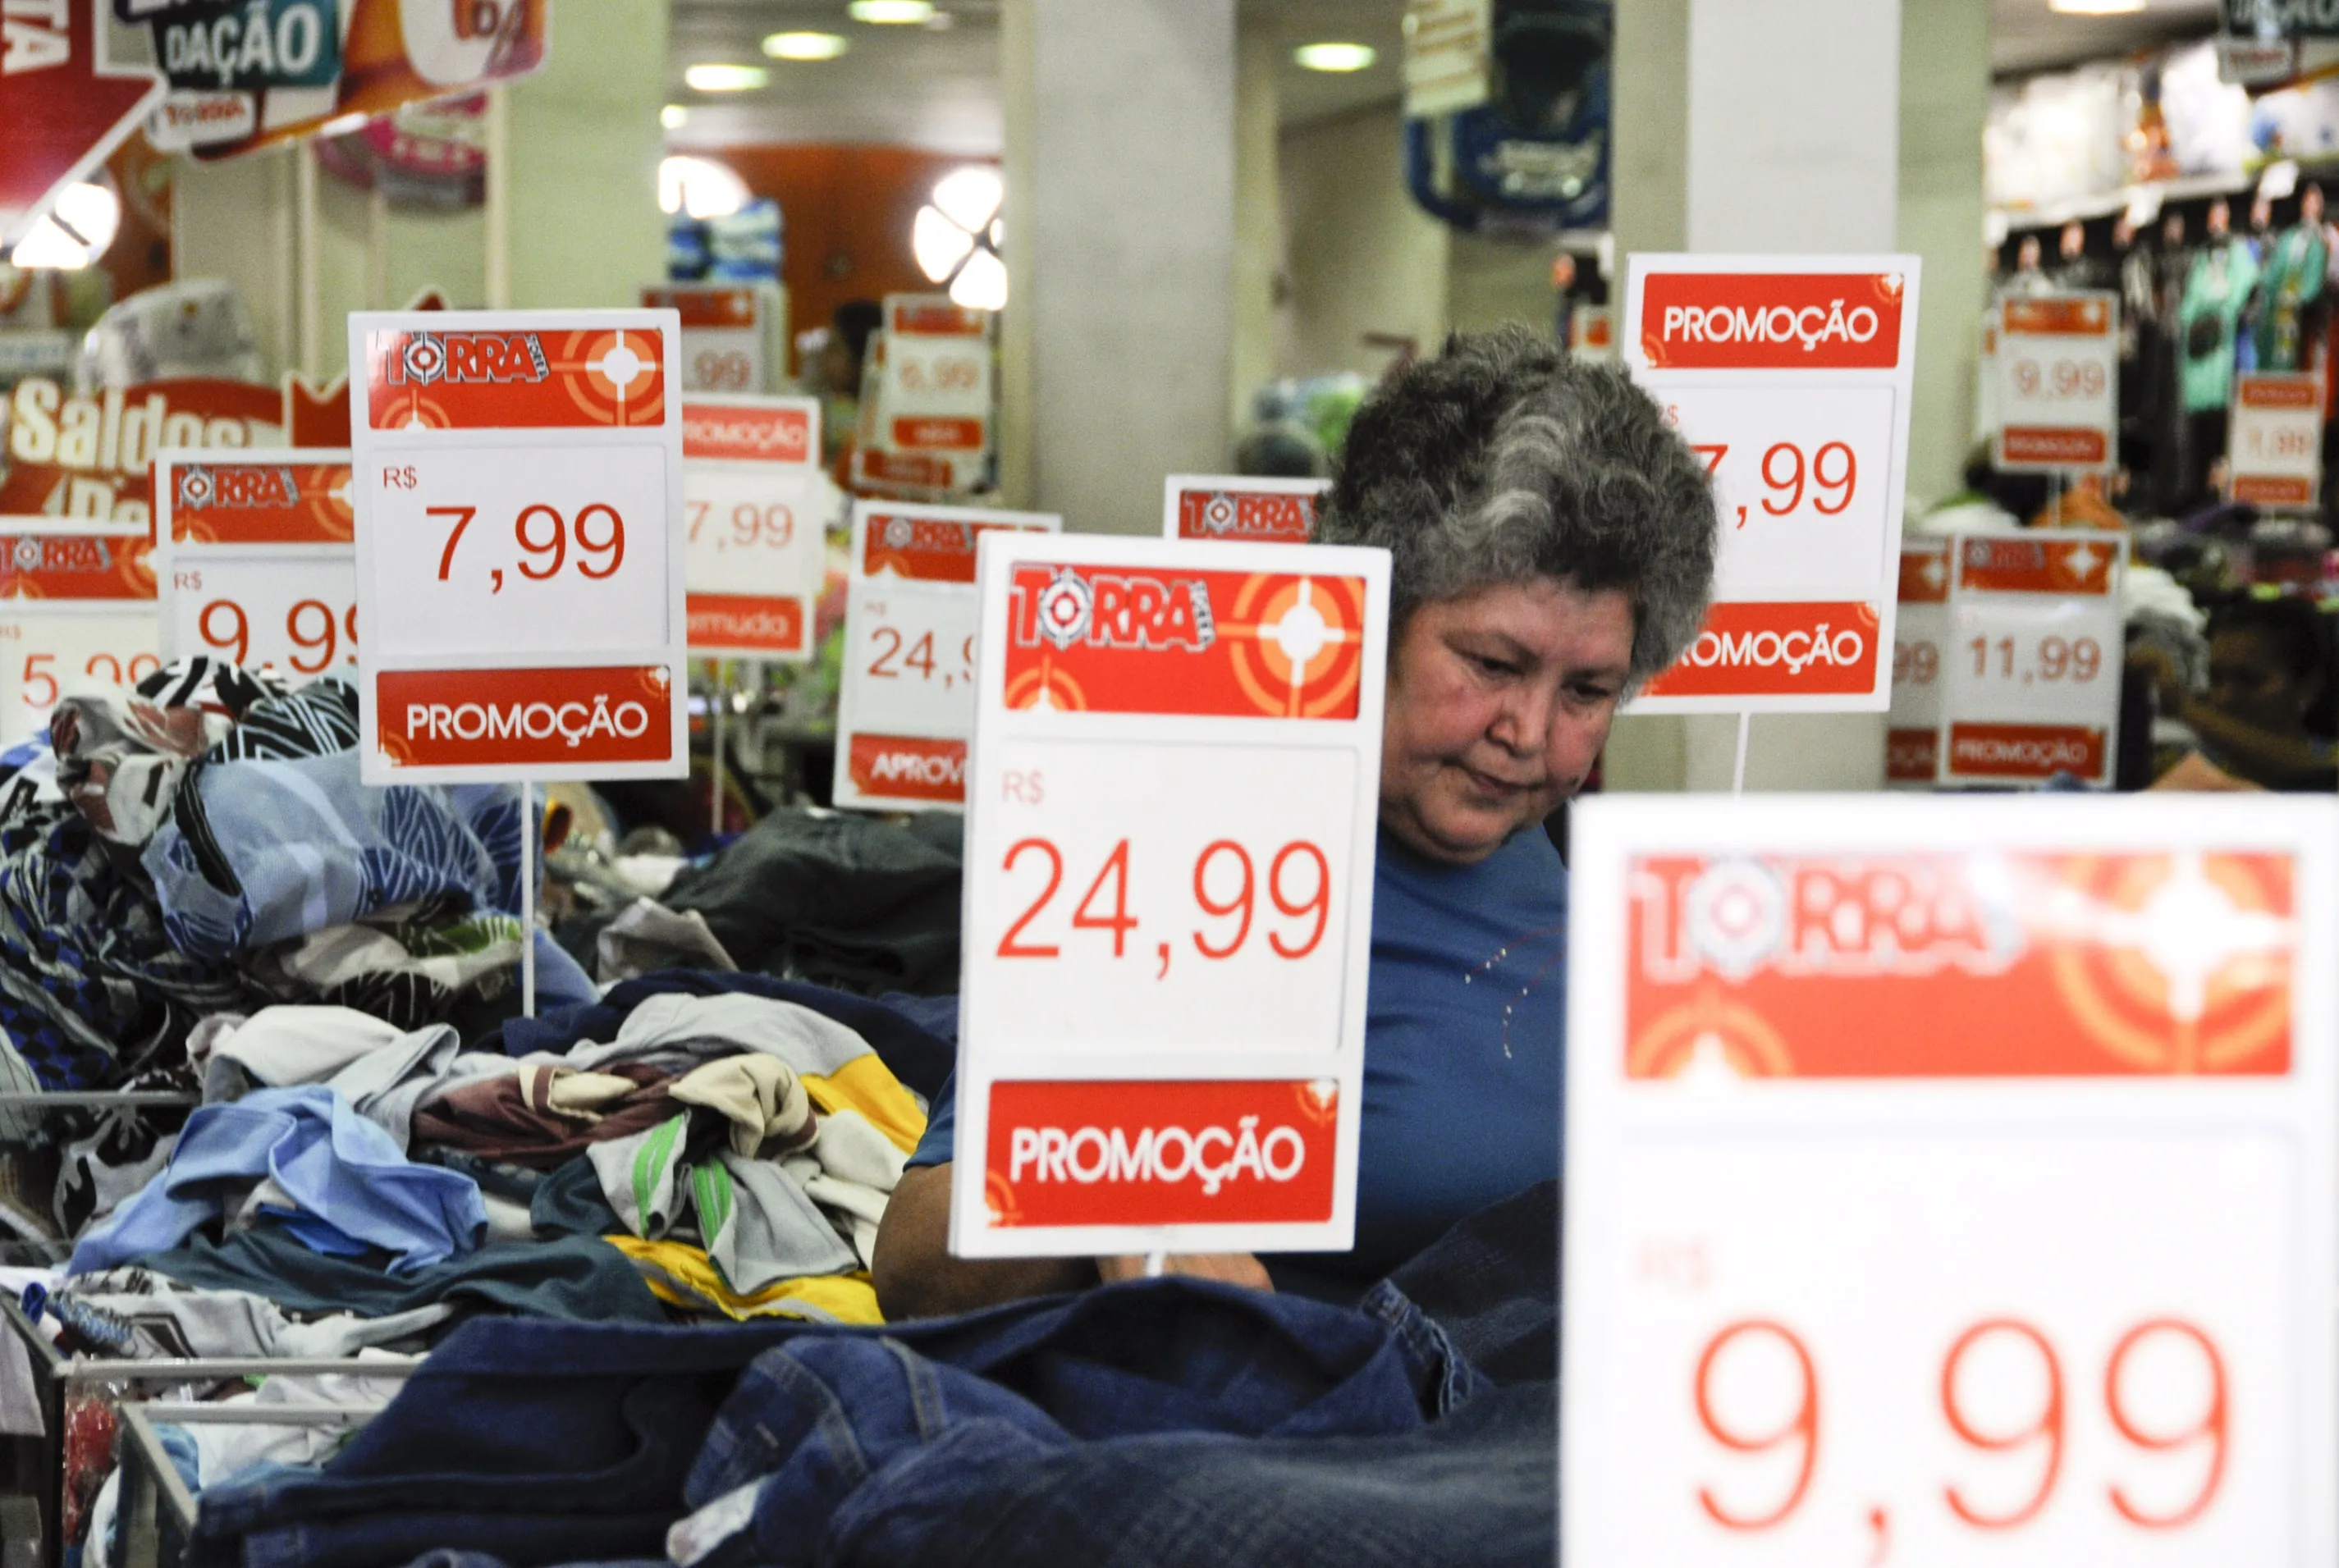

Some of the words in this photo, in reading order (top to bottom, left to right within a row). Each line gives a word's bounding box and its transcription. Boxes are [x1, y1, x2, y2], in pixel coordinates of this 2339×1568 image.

[1663, 299, 1879, 351] PROMOÇÃO
[382, 464, 418, 491] R$
[1186, 492, 1312, 534] TORRA
[426, 502, 625, 595] 7,99
[1012, 565, 1203, 652] TORRA
[1967, 634, 2103, 688] 11,99
[407, 694, 649, 747] PROMOÇÃO
[1000, 769, 1045, 806] R$
[996, 836, 1331, 981] 24,99
[1009, 1114, 1306, 1195] PROMOÇÃO
[1693, 1317, 2231, 1568] 9,99
